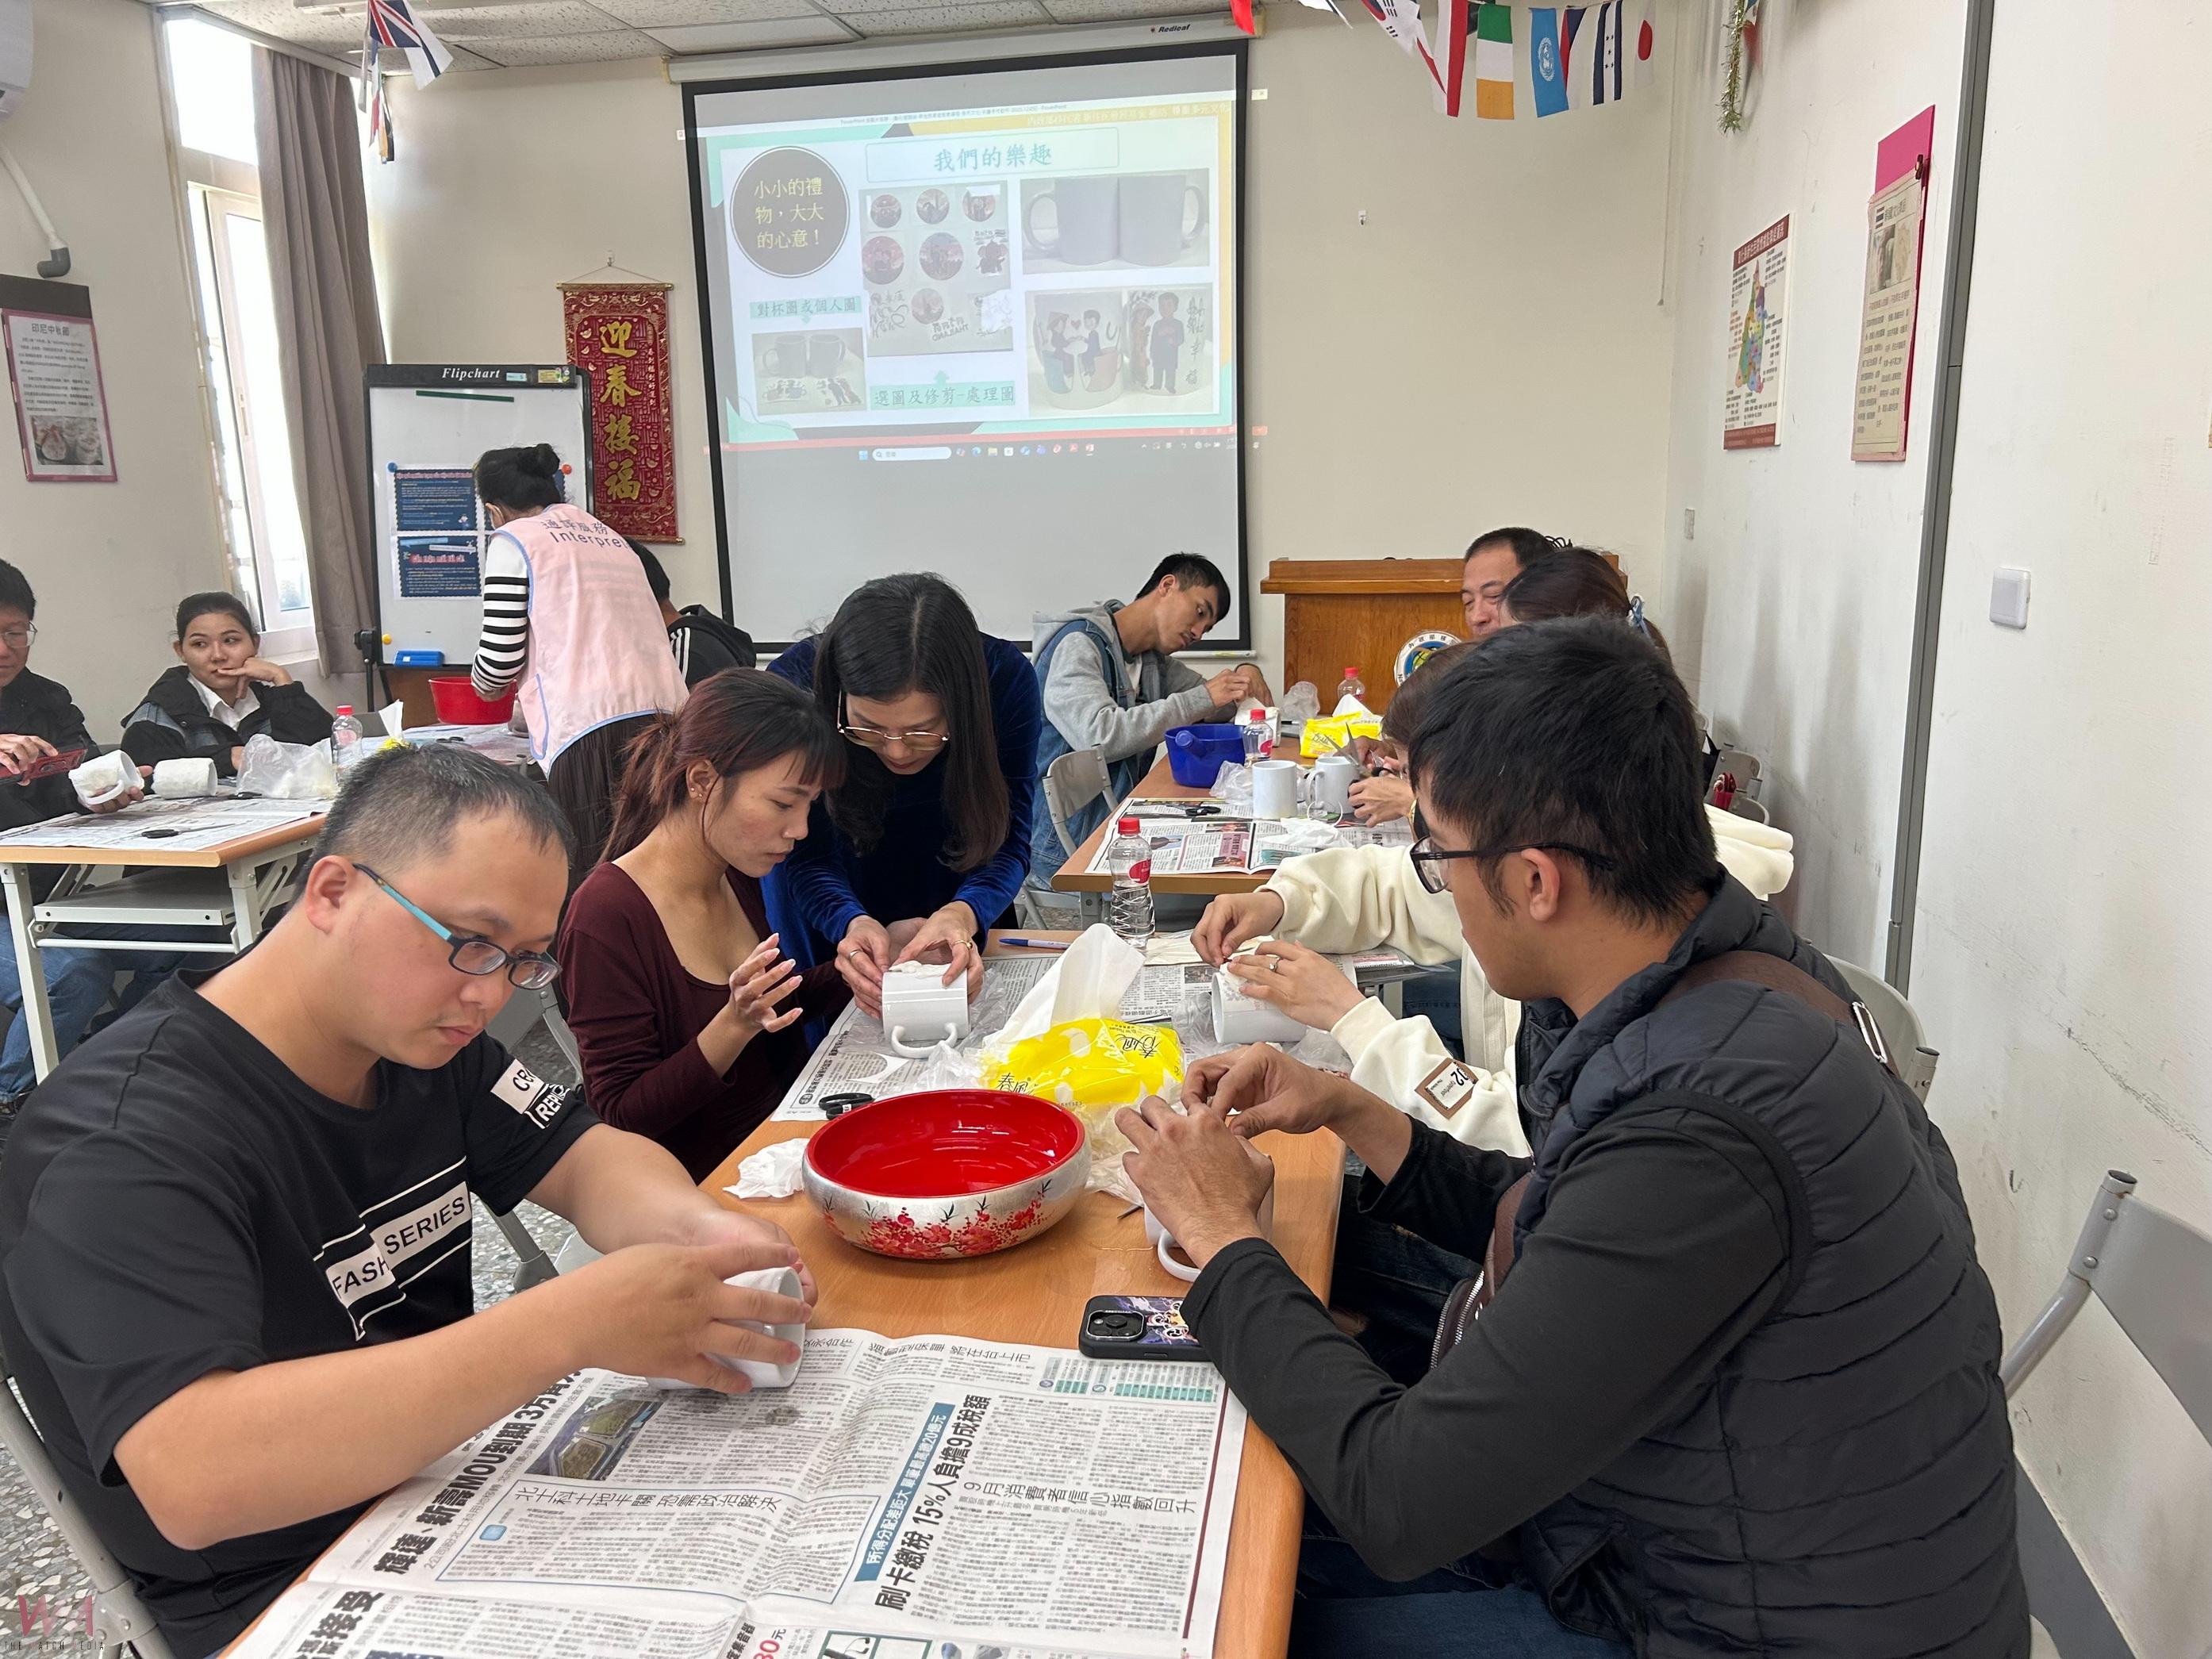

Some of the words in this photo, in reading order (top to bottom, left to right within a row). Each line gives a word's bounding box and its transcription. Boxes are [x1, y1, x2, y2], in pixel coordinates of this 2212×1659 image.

[933, 143, 1052, 171] 我們的樂趣
[754, 177, 824, 199] 小小的禮
[755, 202, 824, 225] 物，大大
[757, 298, 857, 317] 對杯圖或個人圖
[442, 367, 501, 381] Flipchart
[599, 321, 643, 501] 迎春接福
[540, 519, 609, 536] 通譯服務
[383, 1196, 466, 1255] SERIES
[373, 1422, 537, 1576] 輝達、新壽MOU到期
[515, 1486, 656, 1507] 北士科土地卡關
[656, 1493, 782, 1512] 恐需政治解決
[874, 1520, 934, 1611] 刷卡繳稅
[912, 1394, 992, 1529] 15%人負擔9成稅額
[963, 1480, 1198, 1514] 9月消費者信心指數回升
[865, 1488, 912, 1566] 所得分配差距大
